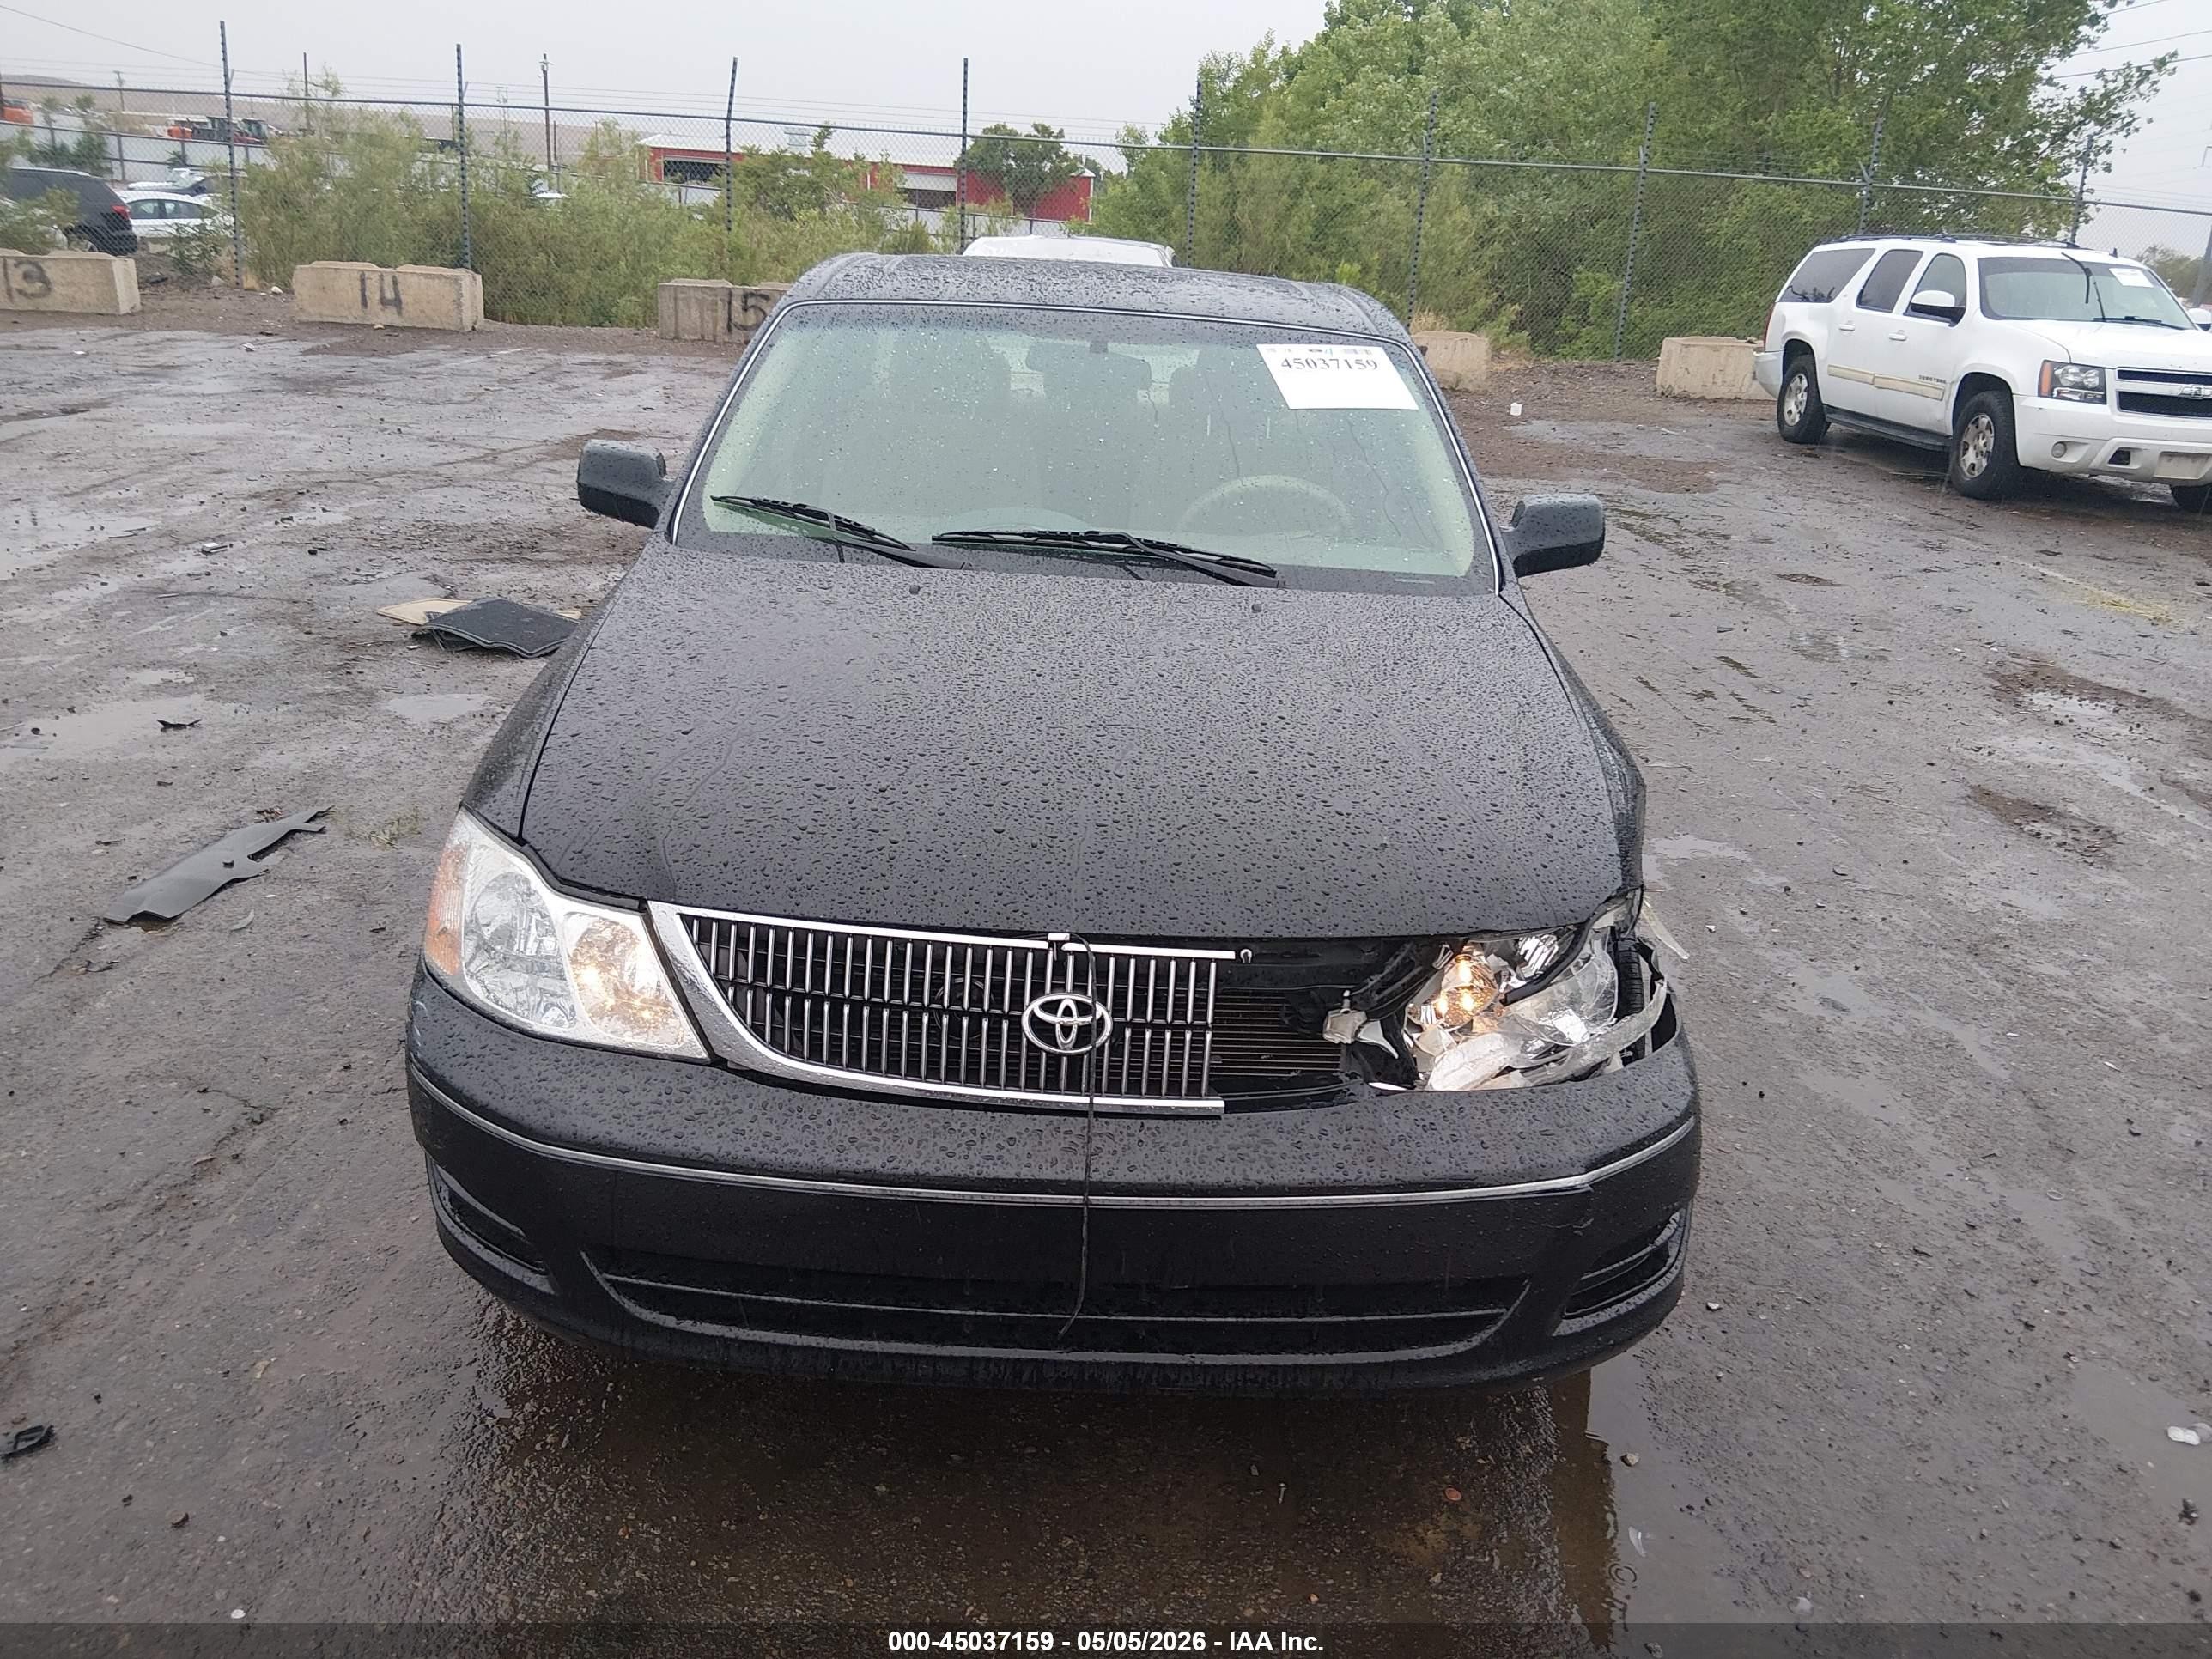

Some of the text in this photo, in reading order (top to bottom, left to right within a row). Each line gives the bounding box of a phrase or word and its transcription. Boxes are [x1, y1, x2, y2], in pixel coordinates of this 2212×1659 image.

[2, 258, 52, 304] 13
[359, 270, 403, 316] 14
[726, 289, 770, 333] 15
[1280, 357, 1378, 370] 45037159
